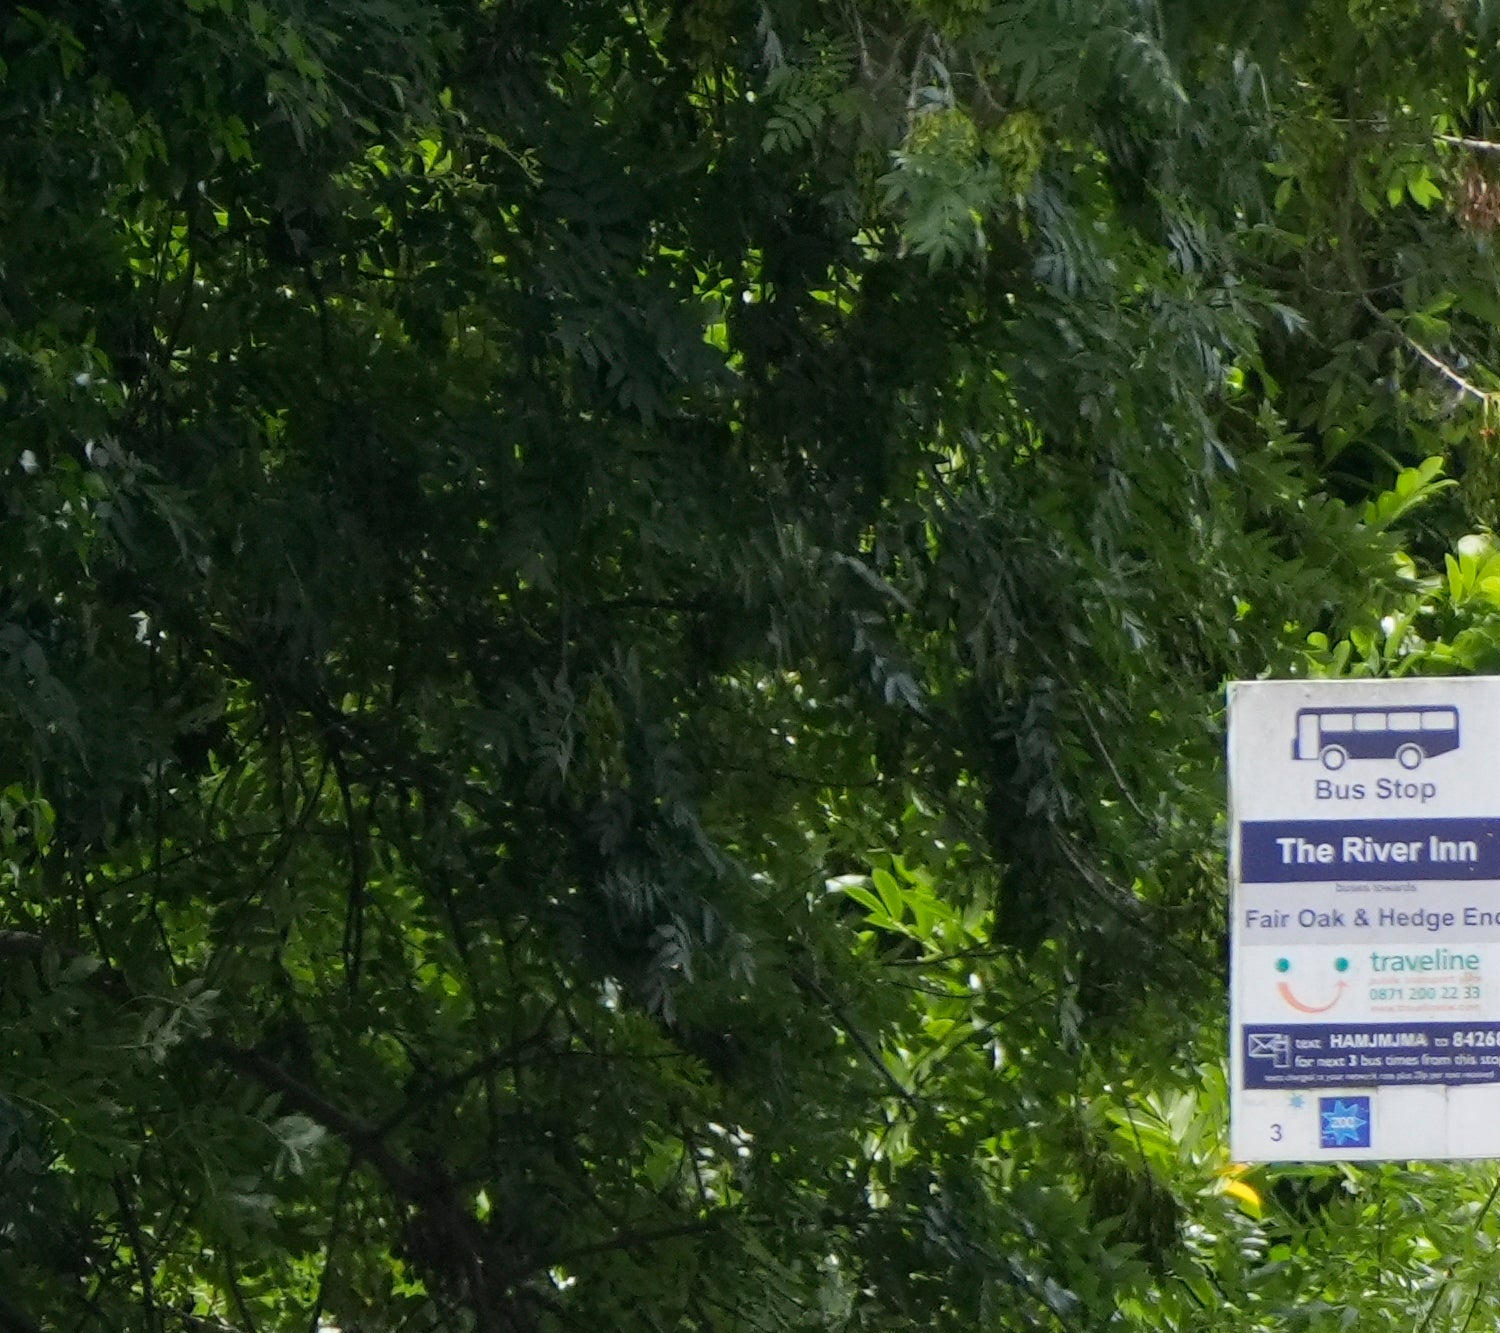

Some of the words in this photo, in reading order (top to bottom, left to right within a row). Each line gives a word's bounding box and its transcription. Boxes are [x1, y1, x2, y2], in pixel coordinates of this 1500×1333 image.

[1315, 779, 1365, 800] Bus
[1376, 777, 1436, 803] Stop
[1276, 838, 1334, 863] The
[1342, 836, 1423, 862] River
[1430, 835, 1478, 861] Inn
[1246, 909, 1289, 929] Fair
[1299, 909, 1345, 927] Oak
[1354, 909, 1370, 927] &
[1379, 908, 1454, 930] Hedge
[1370, 948, 1480, 972] traveline
[1370, 988, 1402, 1000] 0871
[1409, 988, 1436, 1000] 200
[1440, 987, 1458, 999] 22
[1463, 986, 1480, 999] 33
[1295, 1039, 1322, 1049] text
[1434, 1038, 1449, 1047] to
[1294, 1055, 1315, 1068] for
[1317, 1057, 1346, 1067] next
[1348, 1054, 1358, 1067] 3
[1360, 1054, 1382, 1067] bus
[1385, 1055, 1419, 1066] times
[1421, 1053, 1451, 1066] from
[1454, 1053, 1476, 1066] this
[1270, 1123, 1282, 1142] 3
